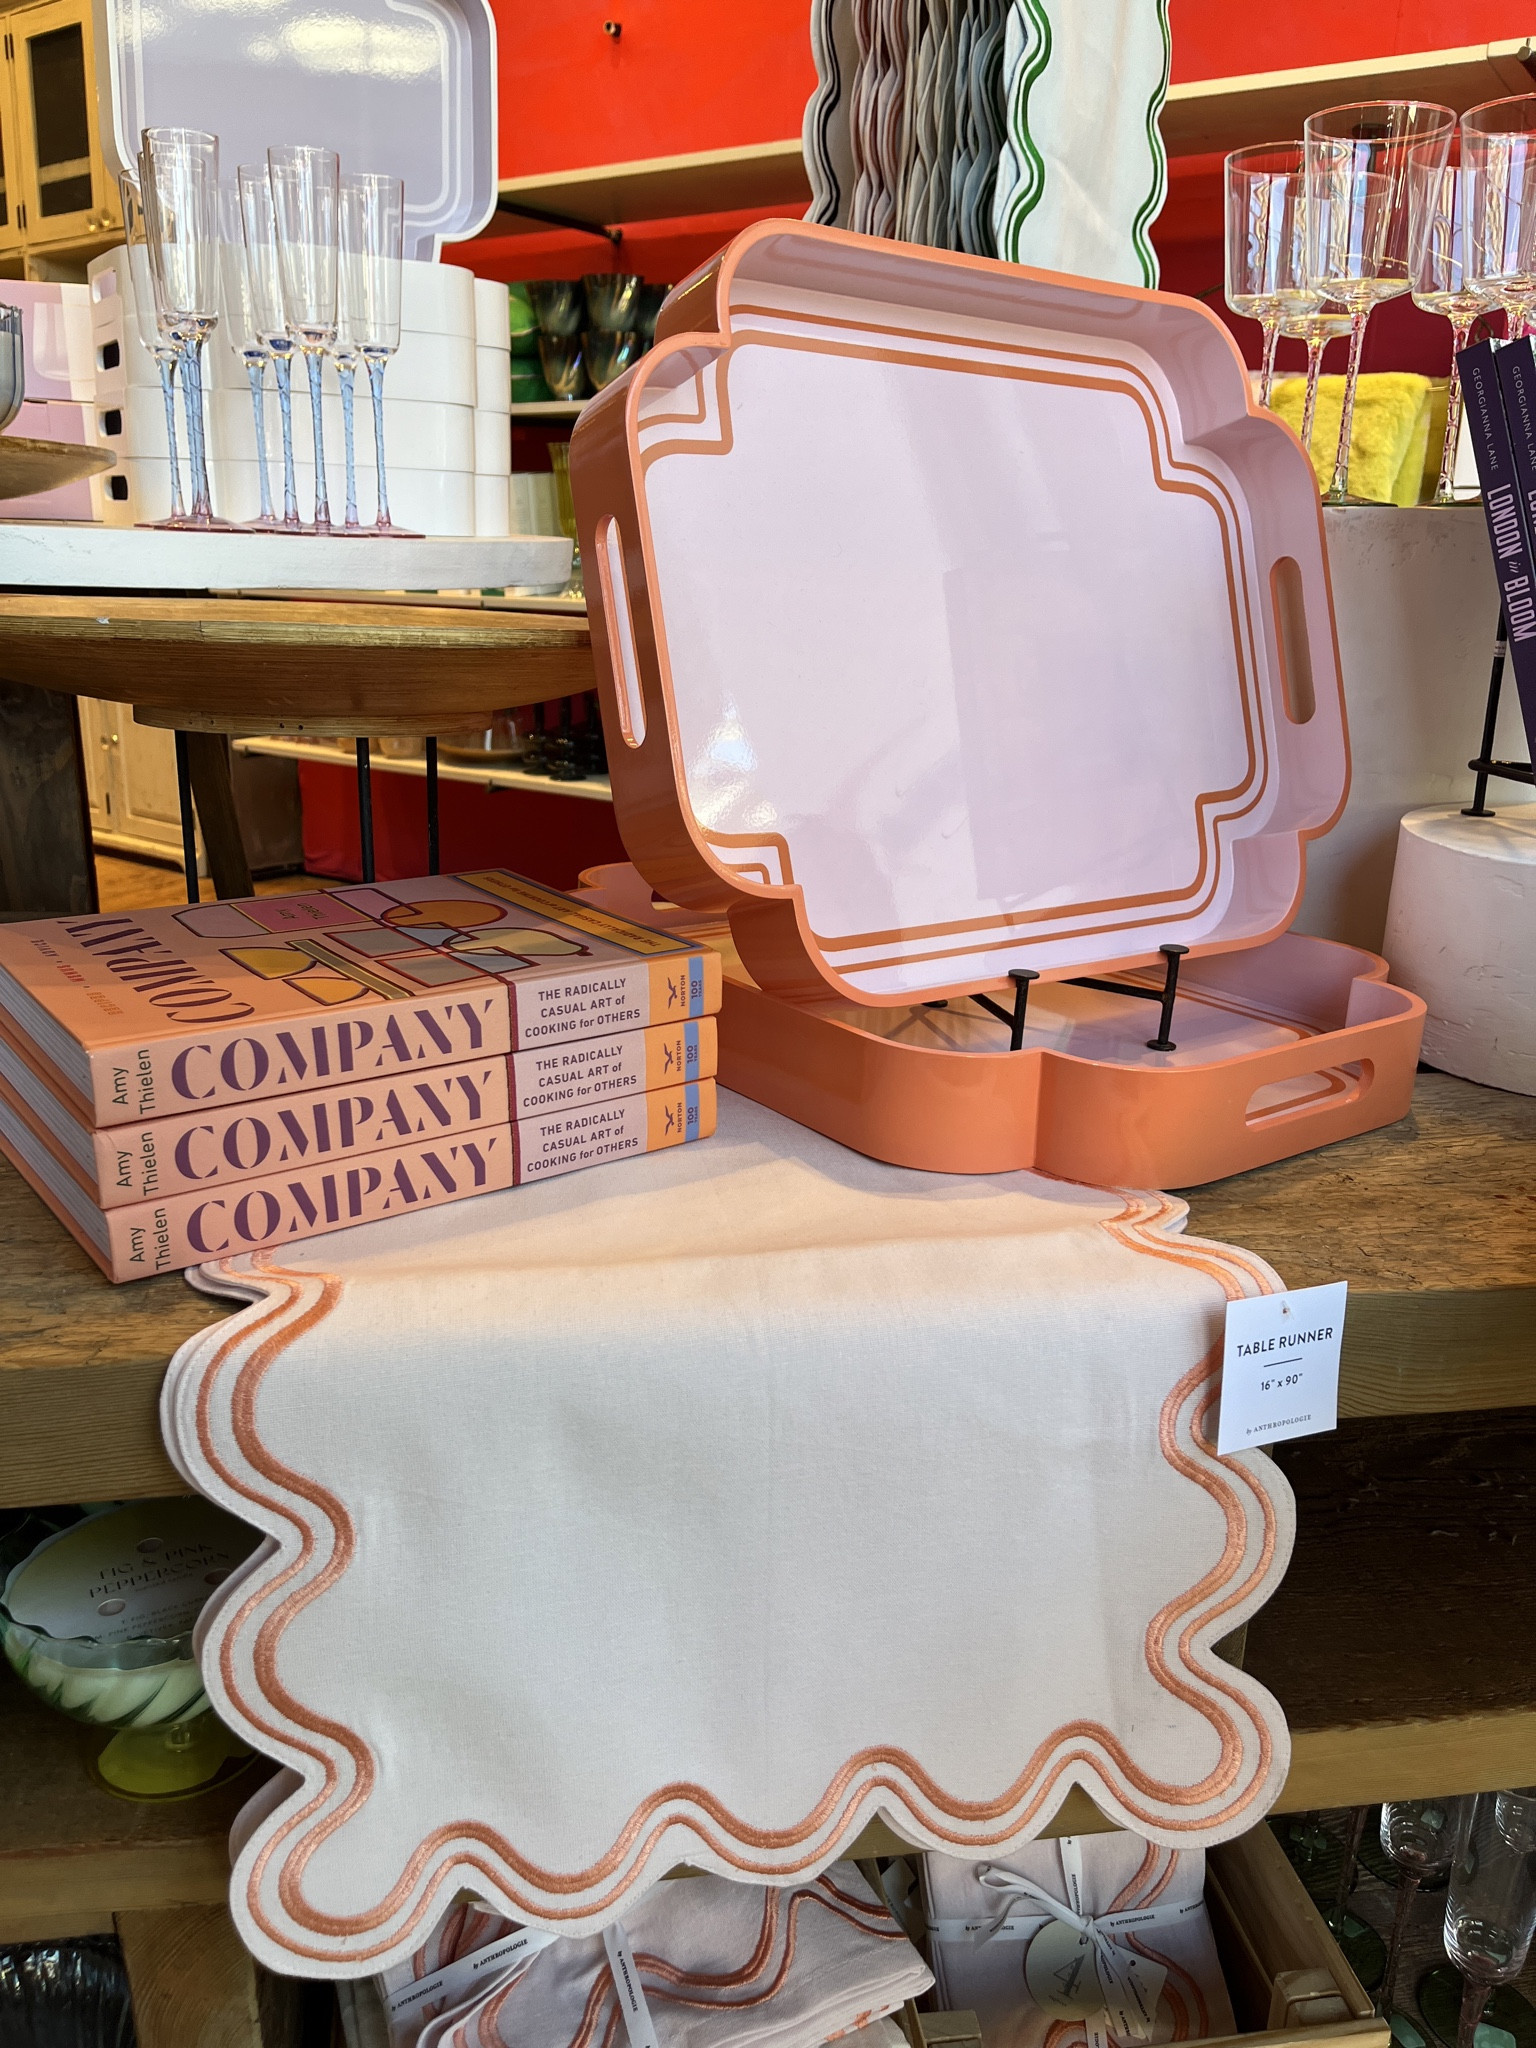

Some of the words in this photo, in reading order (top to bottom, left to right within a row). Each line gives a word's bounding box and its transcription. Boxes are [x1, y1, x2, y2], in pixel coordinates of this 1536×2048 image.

[1472, 367, 1492, 440] GEORGIANNA
[1486, 442, 1499, 471] LANE
[1512, 366, 1533, 440] GEORGIANNA
[1486, 483, 1523, 560] LONDON
[1508, 561, 1521, 573] in
[1503, 574, 1536, 642] BLOOM
[56, 917, 255, 1024] COMPANY
[538, 989, 561, 1001] THE
[564, 978, 627, 997] RADICALLY
[540, 1004, 587, 1018] CASUAL
[590, 997, 612, 1010] ART
[615, 995, 625, 1005] of
[690, 980, 698, 999] 100
[525, 1020, 577, 1038] COOKING
[579, 1018, 595, 1028] for
[596, 1009, 640, 1025] OTHERS
[170, 998, 494, 1100] COMPANY
[536, 1058, 559, 1071] THE
[562, 1045, 623, 1066] RADICALLY
[686, 1045, 694, 1064] 100
[112, 1067, 130, 1105] Amy
[136, 1049, 155, 1114] Thielen
[523, 1089, 574, 1108] COOKING
[577, 1086, 592, 1096] for
[594, 1075, 637, 1092] OTHERS
[538, 1072, 585, 1088] CASUAL
[587, 1065, 610, 1077] ART
[612, 1062, 622, 1072] of
[174, 1070, 493, 1180] COMPANY
[540, 1124, 562, 1137] THE
[565, 1109, 625, 1131] RADICALLY
[542, 1138, 588, 1153] CASUAL
[590, 1129, 612, 1142] ART
[614, 1126, 625, 1136] of
[116, 1151, 133, 1187] Amy
[140, 1132, 159, 1196] Thielen
[527, 1155, 577, 1173] COOKING
[579, 1150, 595, 1160] for
[596, 1138, 639, 1155] OTHERS
[186, 1137, 497, 1253] COMPANY
[129, 1227, 146, 1262] Amy
[153, 1207, 171, 1270] Thielen
[1237, 1338, 1275, 1357] TABLE
[1279, 1327, 1333, 1349] RUNNER
[1260, 1378, 1276, 1391] 16"
[1276, 1379, 1283, 1388] x
[1285, 1372, 1304, 1386] 90"
[1246, 1427, 1252, 1436] by
[1253, 1414, 1312, 1433] ANTHROPOLOGIE
[89, 1552, 229, 1598] PEPPERCORN
[100, 1563, 134, 1579] FIG
[165, 1544, 213, 1561] PINK
[1115, 1914, 1155, 1926] ANTHROPOLOGIE
[473, 1962, 479, 1970] by
[480, 1938, 528, 1967] ANTHROPOLOGIE
[397, 1980, 443, 2007] ANTHROPOLOGIE
[620, 1958, 638, 2012] ANTHROPOLOGIE
